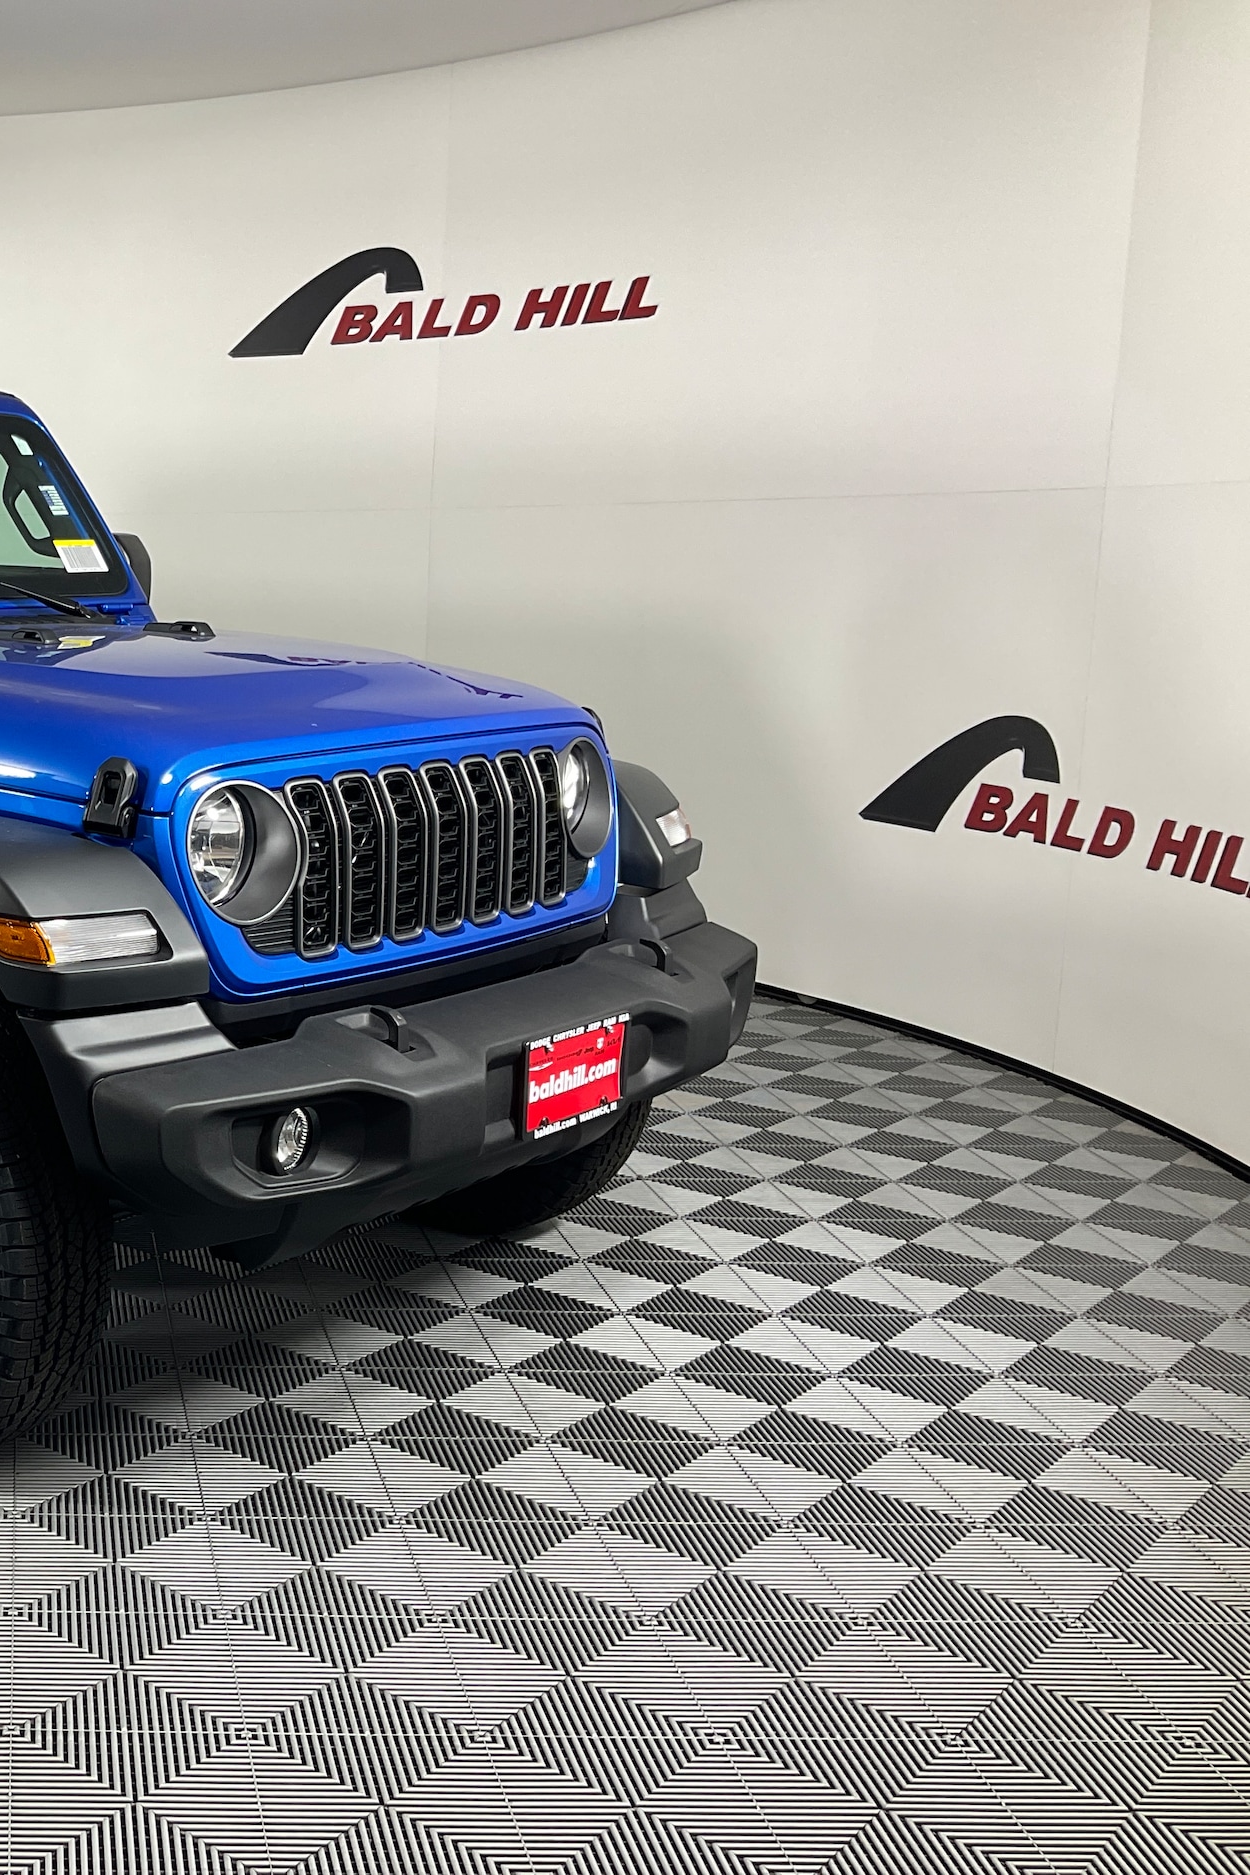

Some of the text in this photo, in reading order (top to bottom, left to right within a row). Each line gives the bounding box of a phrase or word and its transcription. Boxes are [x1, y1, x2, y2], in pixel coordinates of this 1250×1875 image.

[330, 275, 659, 345] BALD HILL
[964, 783, 1250, 898] BALD HIL
[530, 1036, 552, 1051] DODGE
[553, 1026, 585, 1042] CHRYSLER
[586, 1021, 602, 1033] JEEP
[529, 1058, 617, 1104] baldhill.com
[533, 1118, 577, 1139] baldhill.com
[610, 1101, 618, 1112] RI
